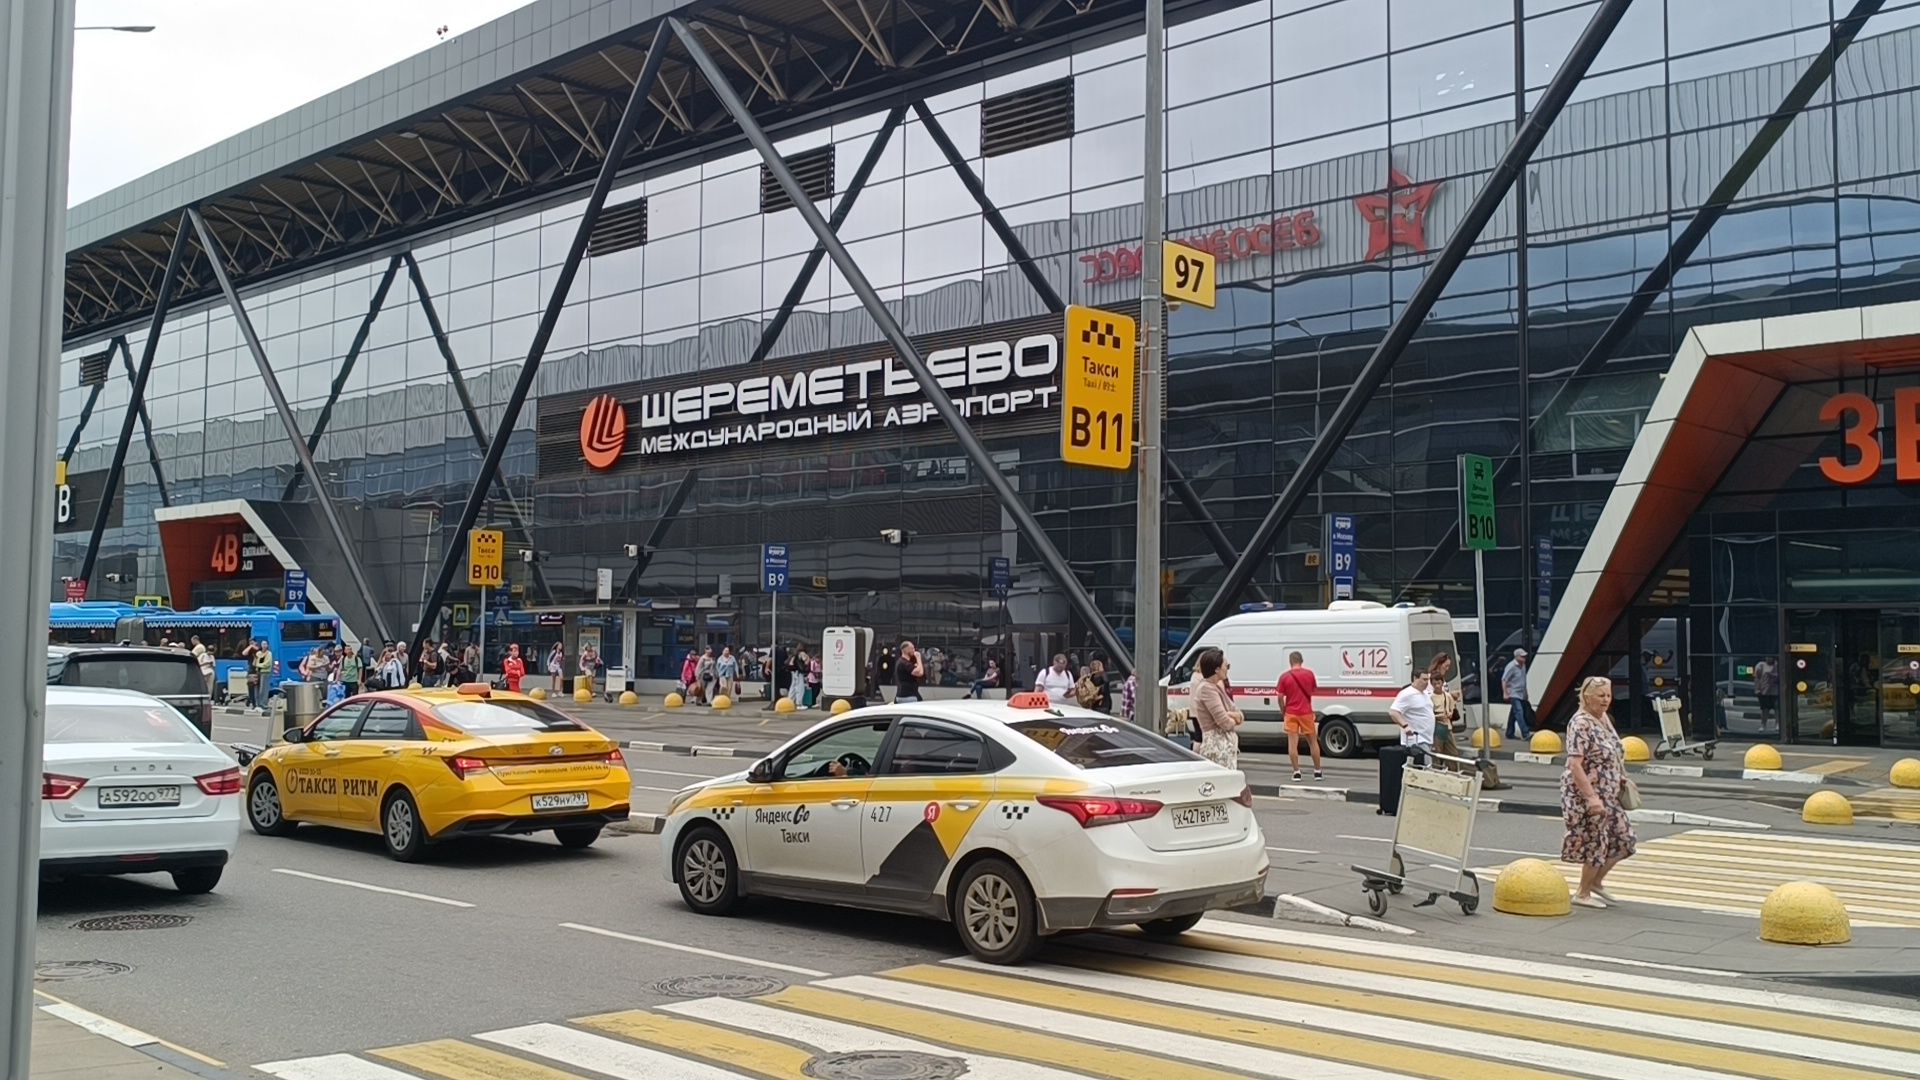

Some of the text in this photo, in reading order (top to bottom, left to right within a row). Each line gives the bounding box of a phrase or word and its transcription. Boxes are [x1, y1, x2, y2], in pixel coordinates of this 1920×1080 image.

[1174, 254, 1205, 293] 97
[1081, 355, 1119, 379] Такси
[641, 333, 1058, 428] ШЕРЕМЕТЬЕВО
[640, 403, 872, 454] МЕЖДУНАРОДНЫЙ
[1070, 406, 1123, 453] B11
[1469, 513, 1494, 540] B10
[211, 534, 238, 572] 4B
[1335, 553, 1352, 571] B9
[472, 564, 499, 579] B10
[768, 573, 785, 587] B9
[288, 590, 303, 600] B9
[1358, 648, 1388, 668] 112
[113, 764, 173, 772] LADA
[299, 777, 379, 797] ТАКСИ РИТМ
[755, 804, 810, 825] Яндекс Go
[870, 806, 892, 823] 427
[927, 806, 936, 819] Я
[780, 828, 810, 843] Такси
